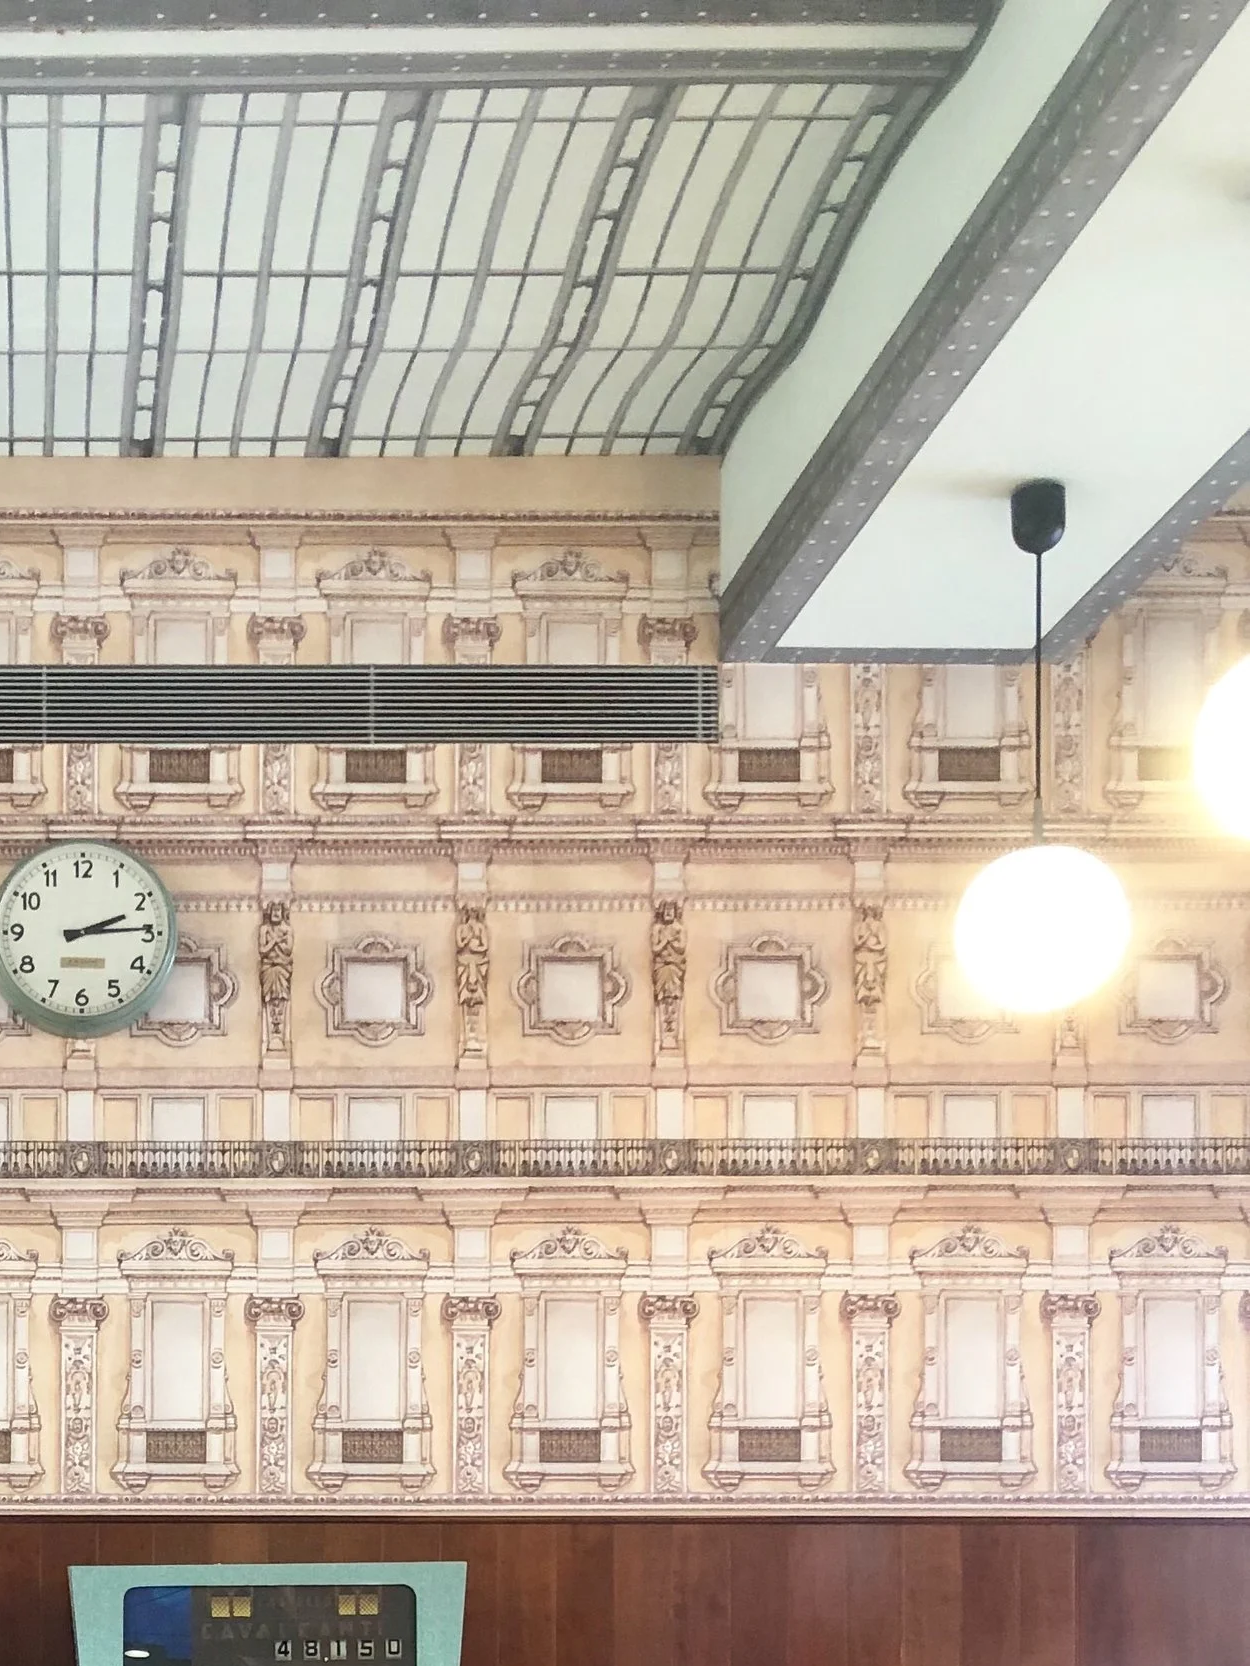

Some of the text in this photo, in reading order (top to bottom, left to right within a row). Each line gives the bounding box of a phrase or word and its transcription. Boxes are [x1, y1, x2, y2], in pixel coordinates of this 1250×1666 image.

[74, 860, 93, 879] 12
[44, 870, 57, 888] 11
[113, 870, 120, 888] 1
[21, 892, 40, 910] 10
[134, 893, 146, 911] 2
[10, 924, 24, 941] 9
[141, 924, 155, 943] 3
[20, 956, 35, 973] 8
[130, 956, 145, 973] 4
[48, 979, 59, 998] 7
[108, 979, 120, 997] 5
[75, 989, 89, 1007] 6
